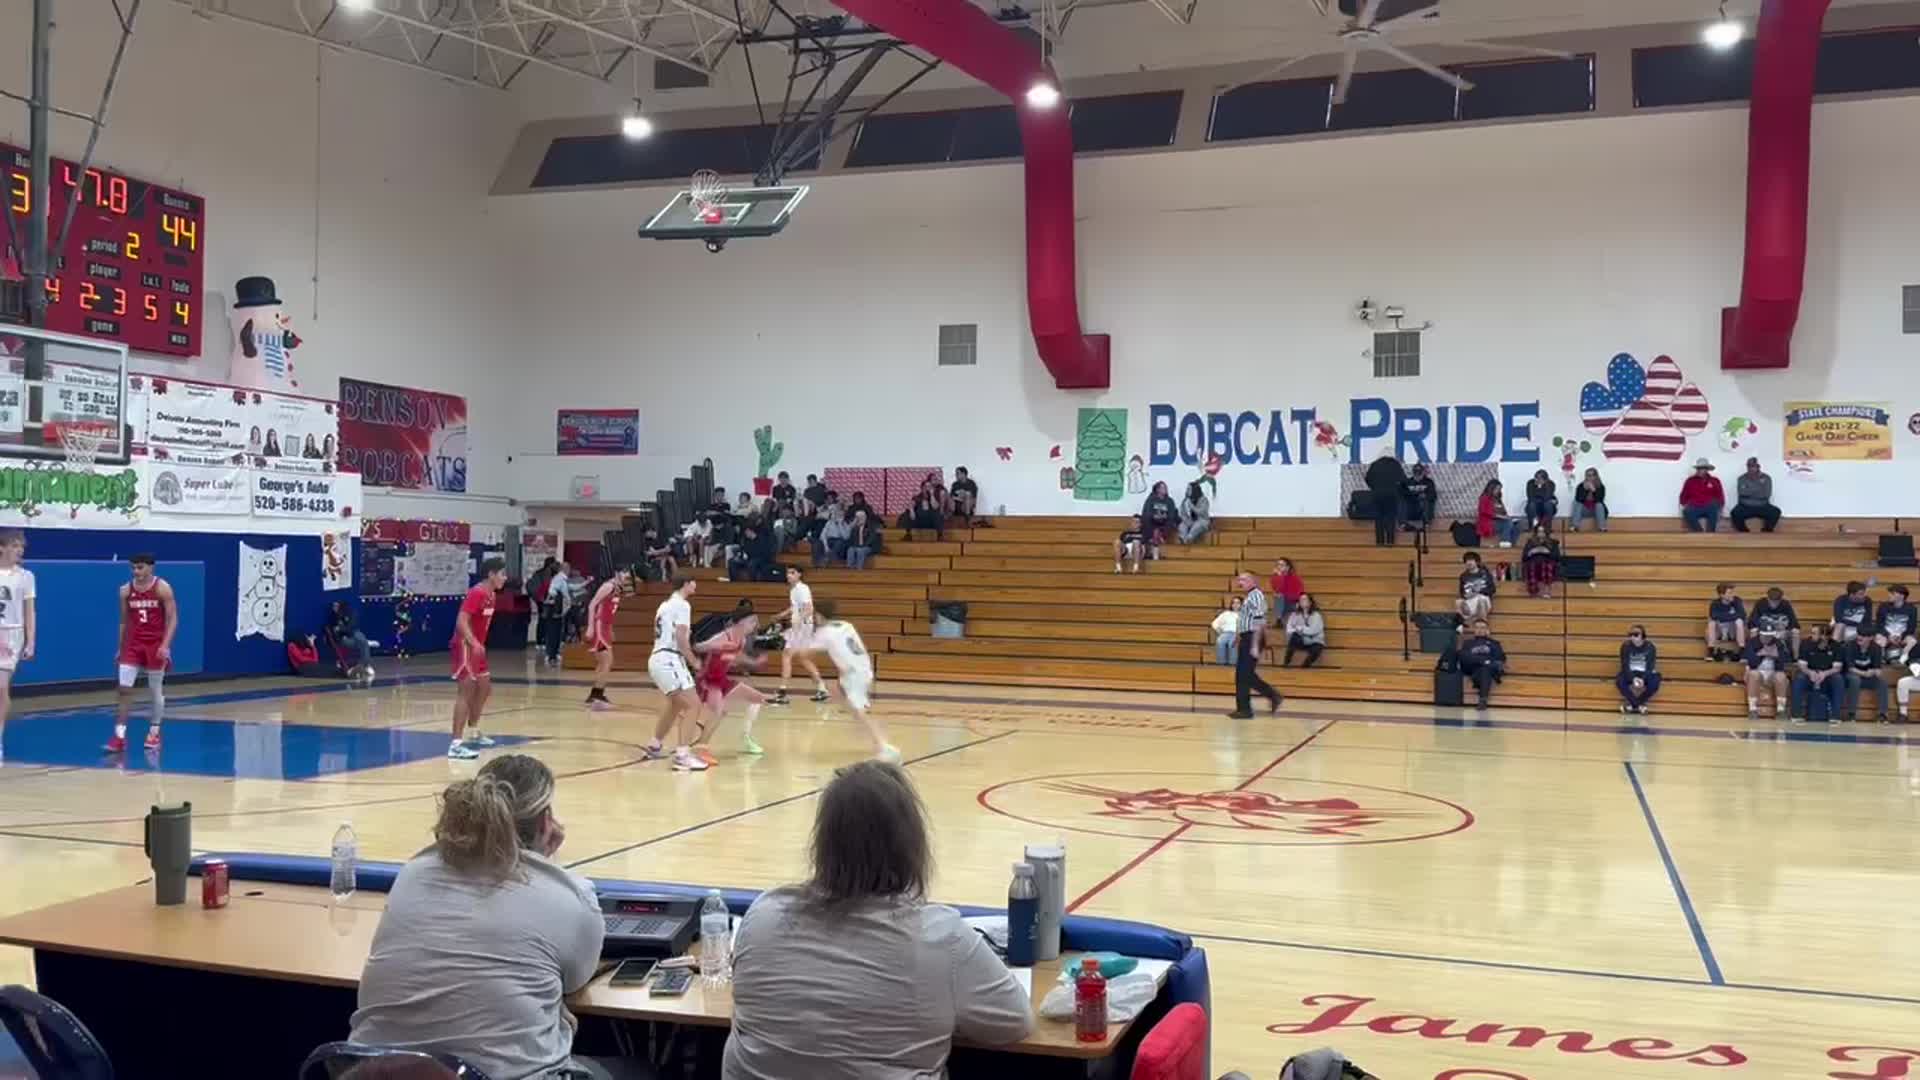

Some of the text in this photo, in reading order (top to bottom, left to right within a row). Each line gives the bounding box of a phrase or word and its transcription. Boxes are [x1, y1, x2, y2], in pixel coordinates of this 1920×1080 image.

[126, 231, 140, 259] 2
[162, 213, 196, 251] 44
[112, 286, 127, 315] 3
[143, 294, 158, 321] 5
[175, 300, 189, 325] 4
[342, 382, 448, 430] BENSON
[1813, 421, 1861, 431] 2021-22
[259, 476, 330, 494] George's Auto
[1265, 994, 1748, 1067] James
